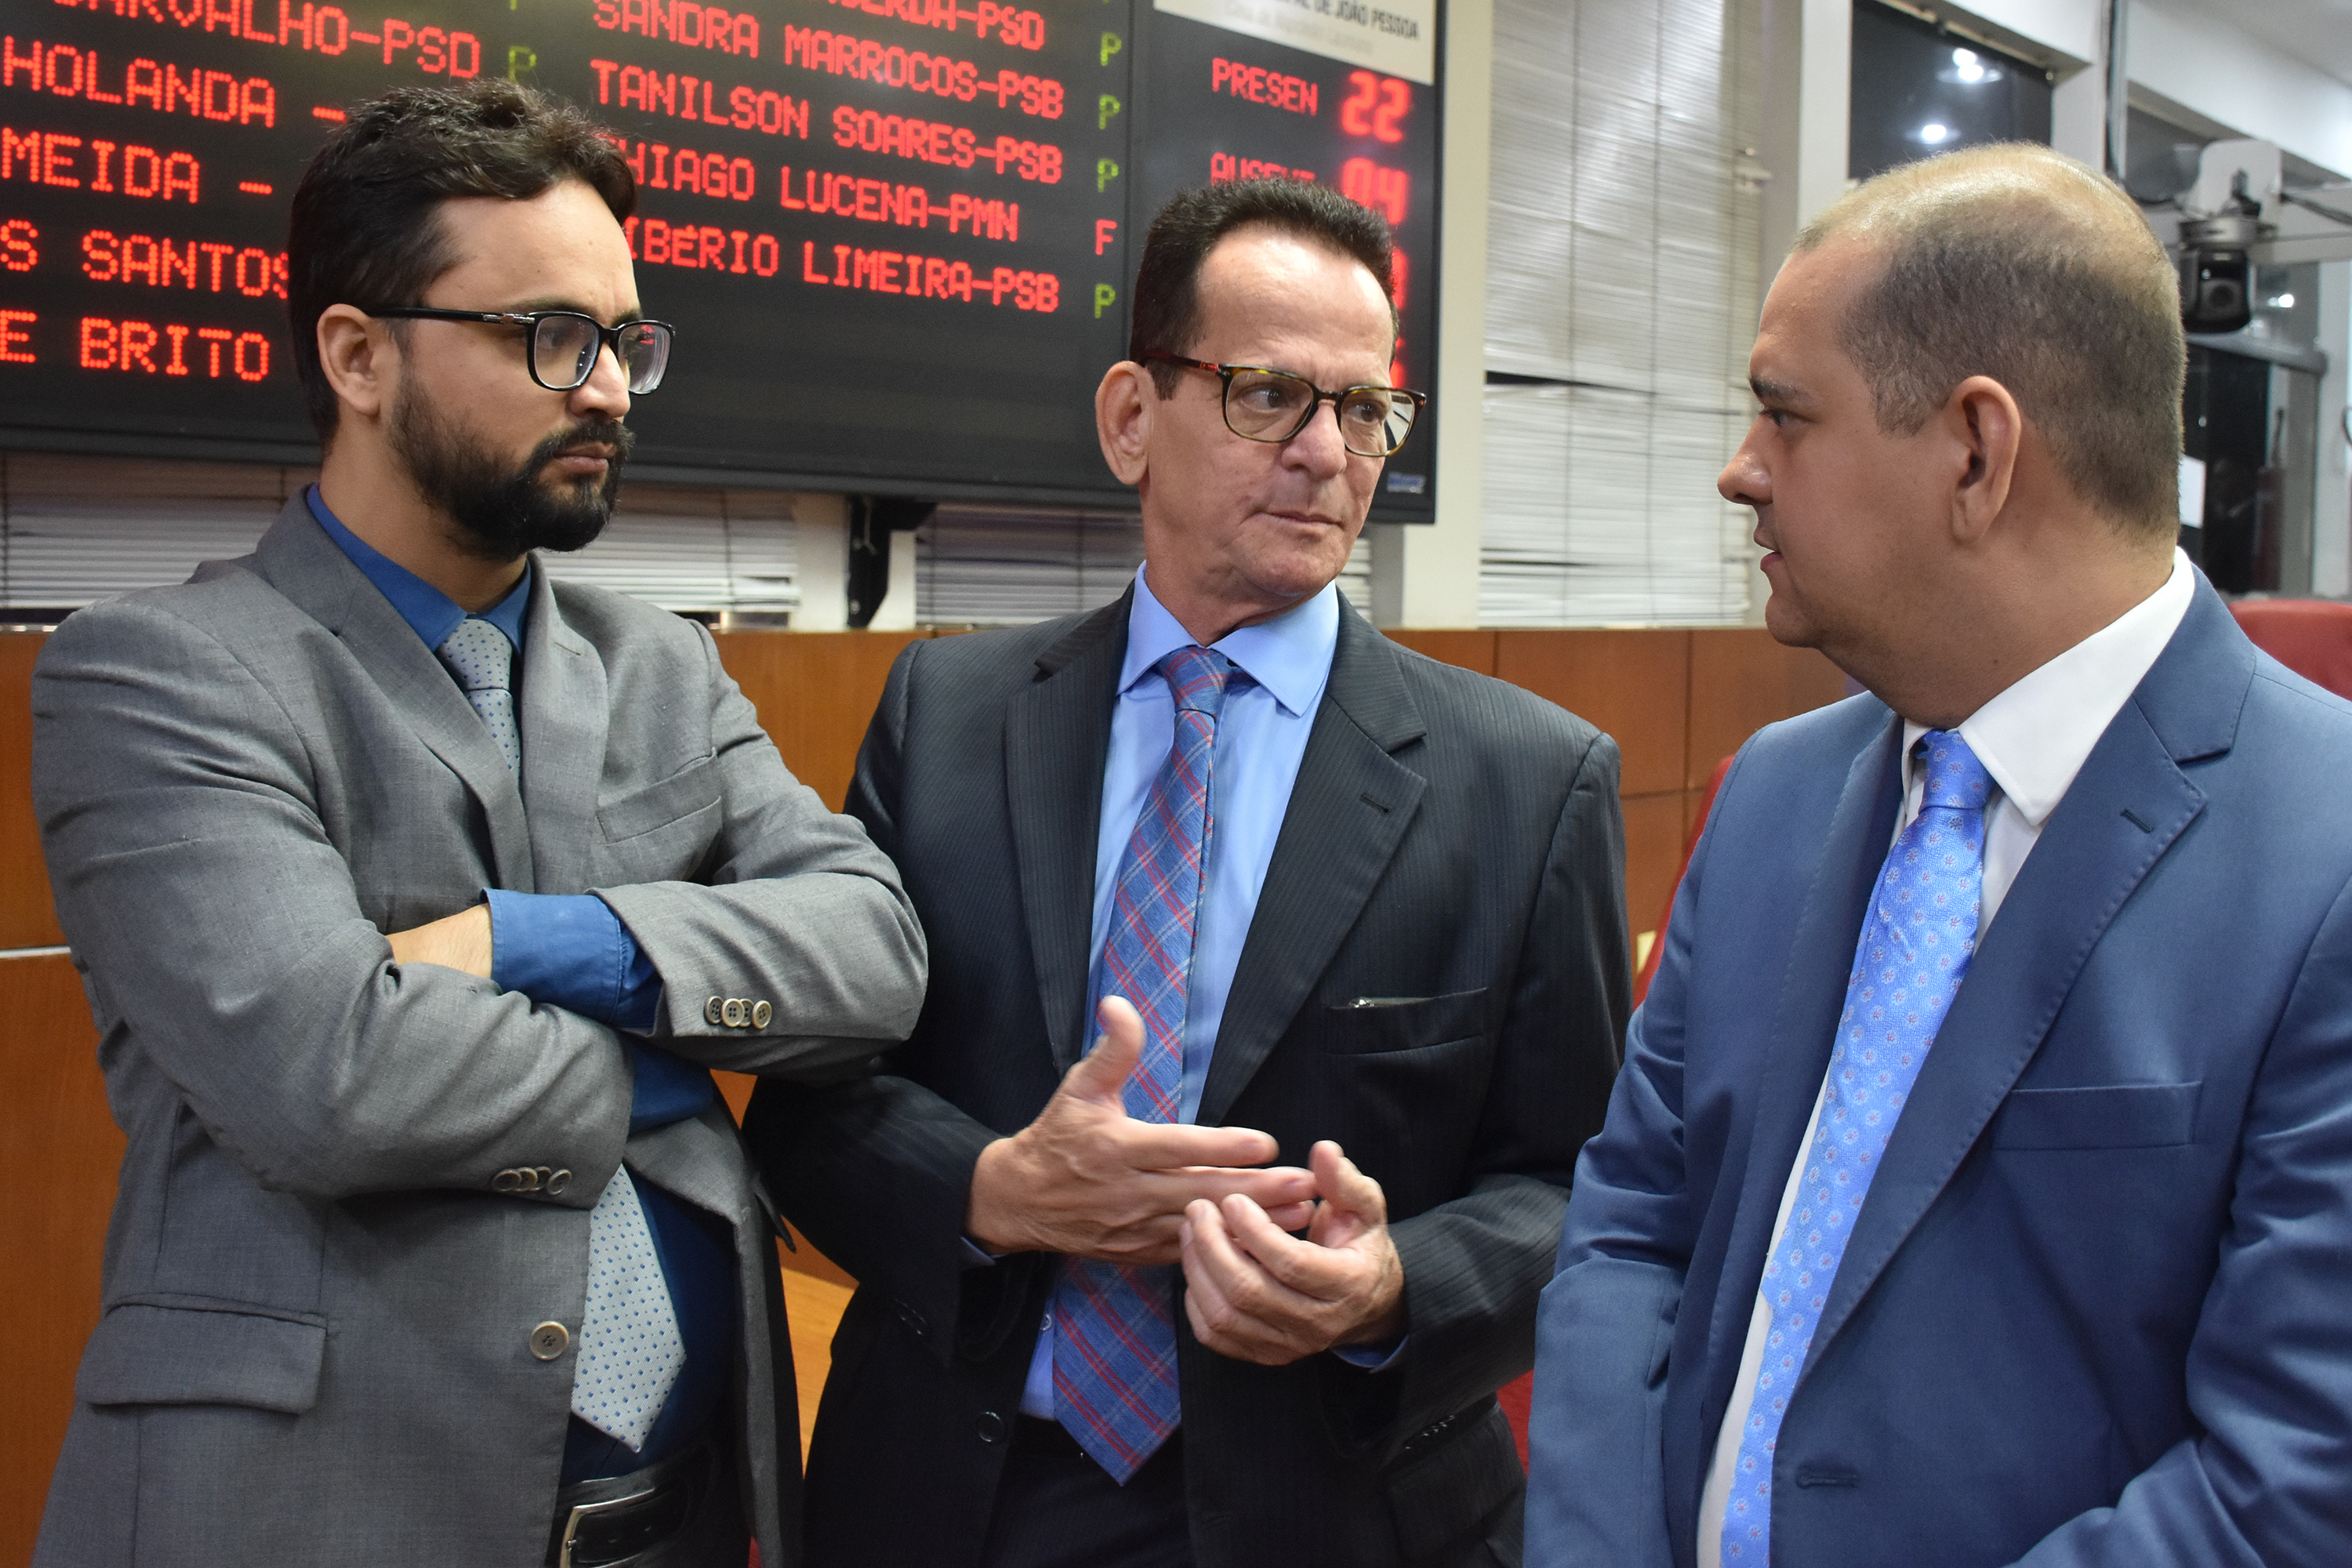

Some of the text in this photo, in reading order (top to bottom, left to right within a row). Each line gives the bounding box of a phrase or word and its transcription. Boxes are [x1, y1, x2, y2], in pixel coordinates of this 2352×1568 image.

[54, 0, 481, 79] VALHO-PSD
[593, 0, 1121, 129] SANDRA MARROCOS-PSB P
[828, 0, 1122, 66] DA-PSD P
[2, 35, 276, 129] HOLANDA
[590, 58, 1120, 192] TANILSON SOARES-PSB P
[1212, 57, 1411, 144] PRESEN 22
[1, 126, 201, 204] MEIDA
[593, 132, 1118, 256] HIAGO LUCENA-PMN F
[624, 216, 1116, 319] IBÉRIO LIMEIRA-PSB P
[81, 316, 270, 382] BRITO
